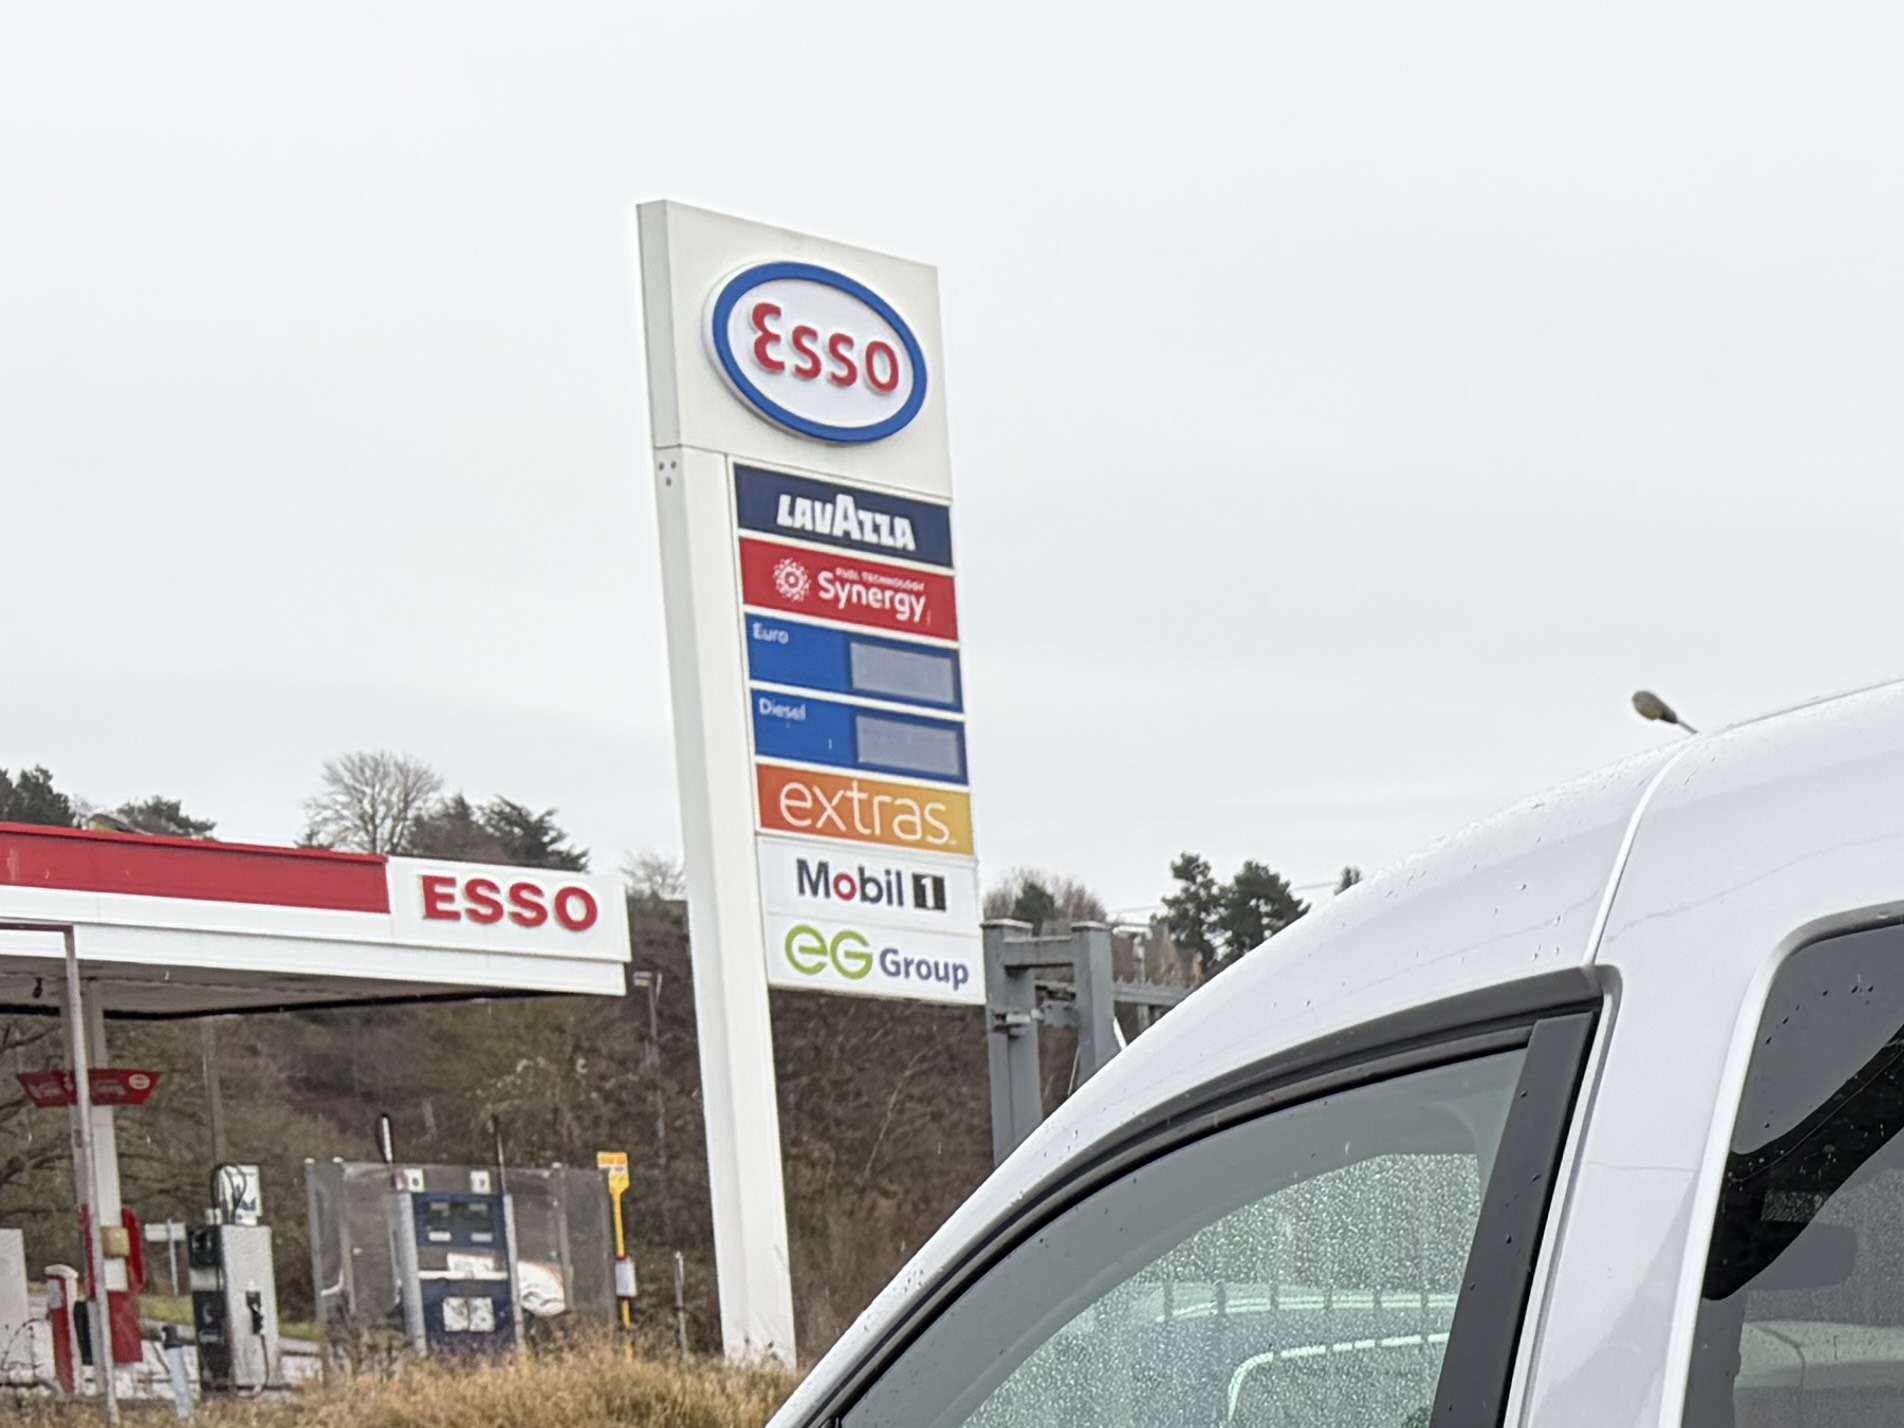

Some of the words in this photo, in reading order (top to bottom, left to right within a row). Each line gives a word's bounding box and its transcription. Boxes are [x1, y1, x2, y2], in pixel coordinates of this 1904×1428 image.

[776, 494, 916, 552] LAVAZZA
[817, 570, 926, 623] Synergy
[752, 622, 789, 645] Euro
[758, 698, 806, 722] Diesel
[780, 780, 951, 846] extras
[419, 873, 598, 932] ESSO
[796, 858, 904, 908] Mobil
[915, 874, 941, 911] 1
[878, 948, 970, 991] Group
